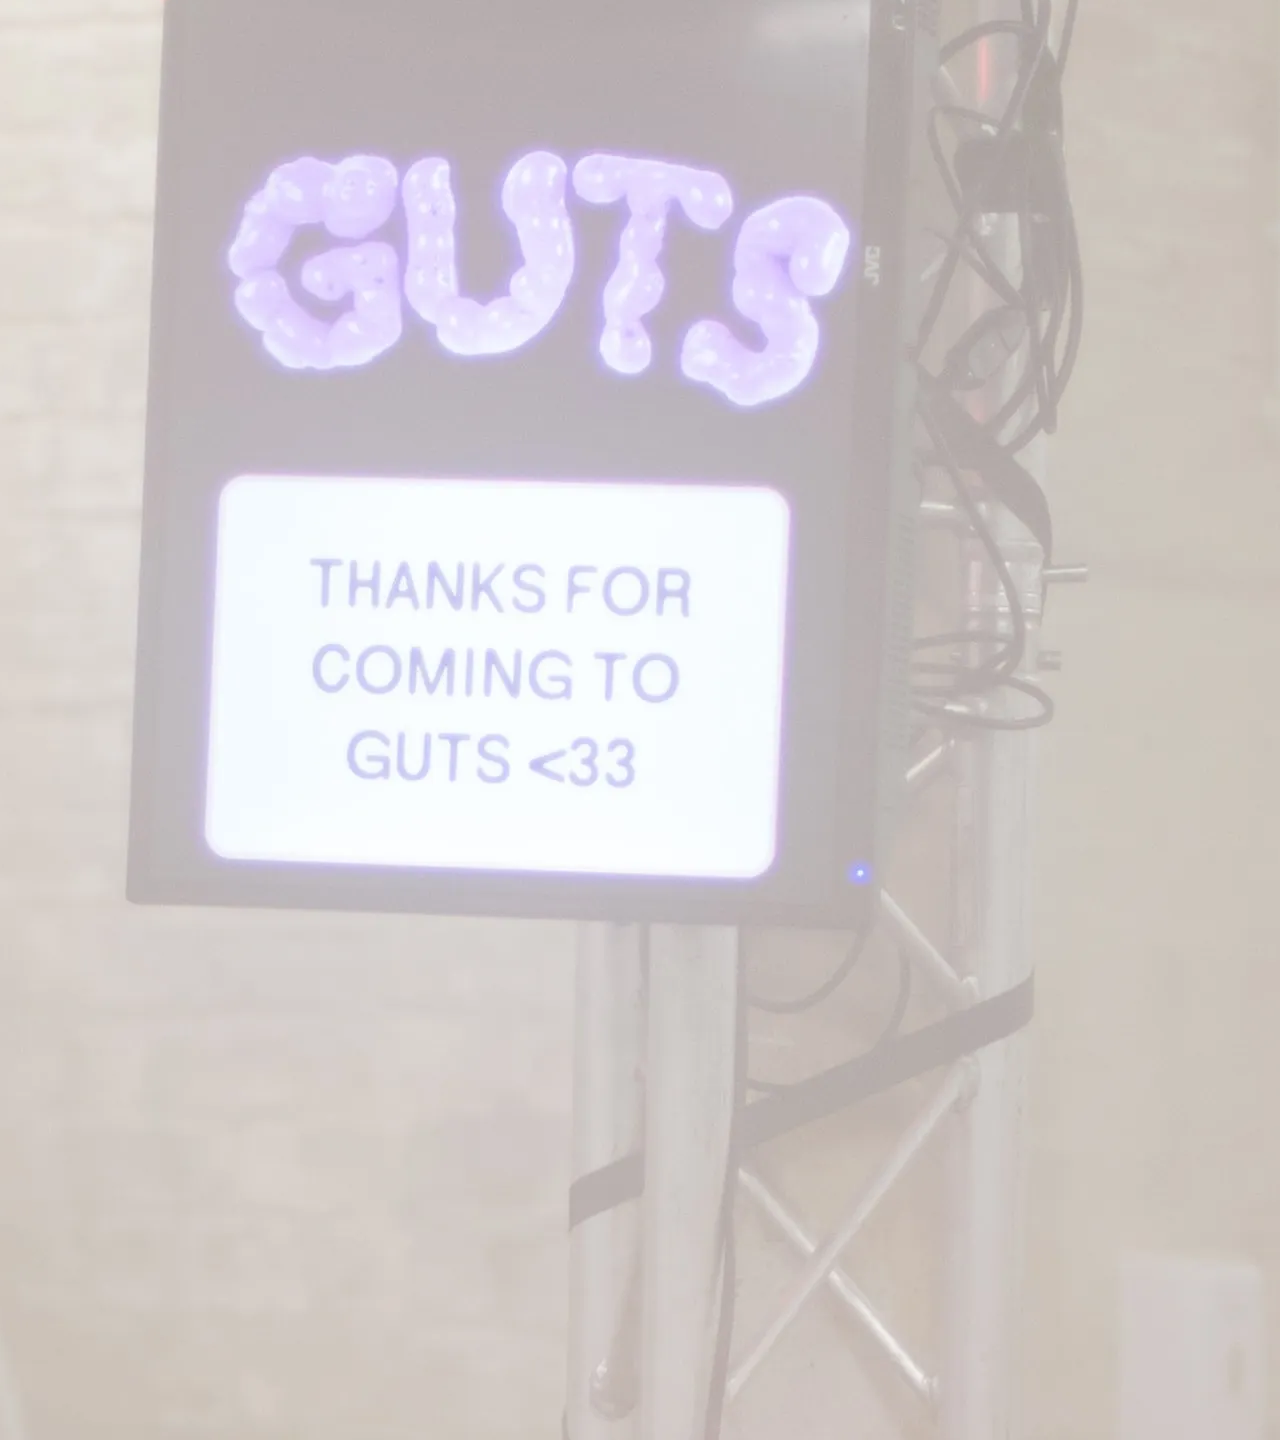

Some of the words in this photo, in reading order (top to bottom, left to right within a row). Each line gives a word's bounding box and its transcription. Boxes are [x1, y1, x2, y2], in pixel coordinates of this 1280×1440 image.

[228, 150, 850, 406] GUTS
[864, 245, 881, 287] JVC
[311, 558, 546, 614] THANKS
[567, 566, 691, 618] FOR
[312, 643, 572, 702] COMING
[594, 652, 680, 703] TO
[347, 730, 510, 784] GUTS
[529, 737, 637, 788] <33
